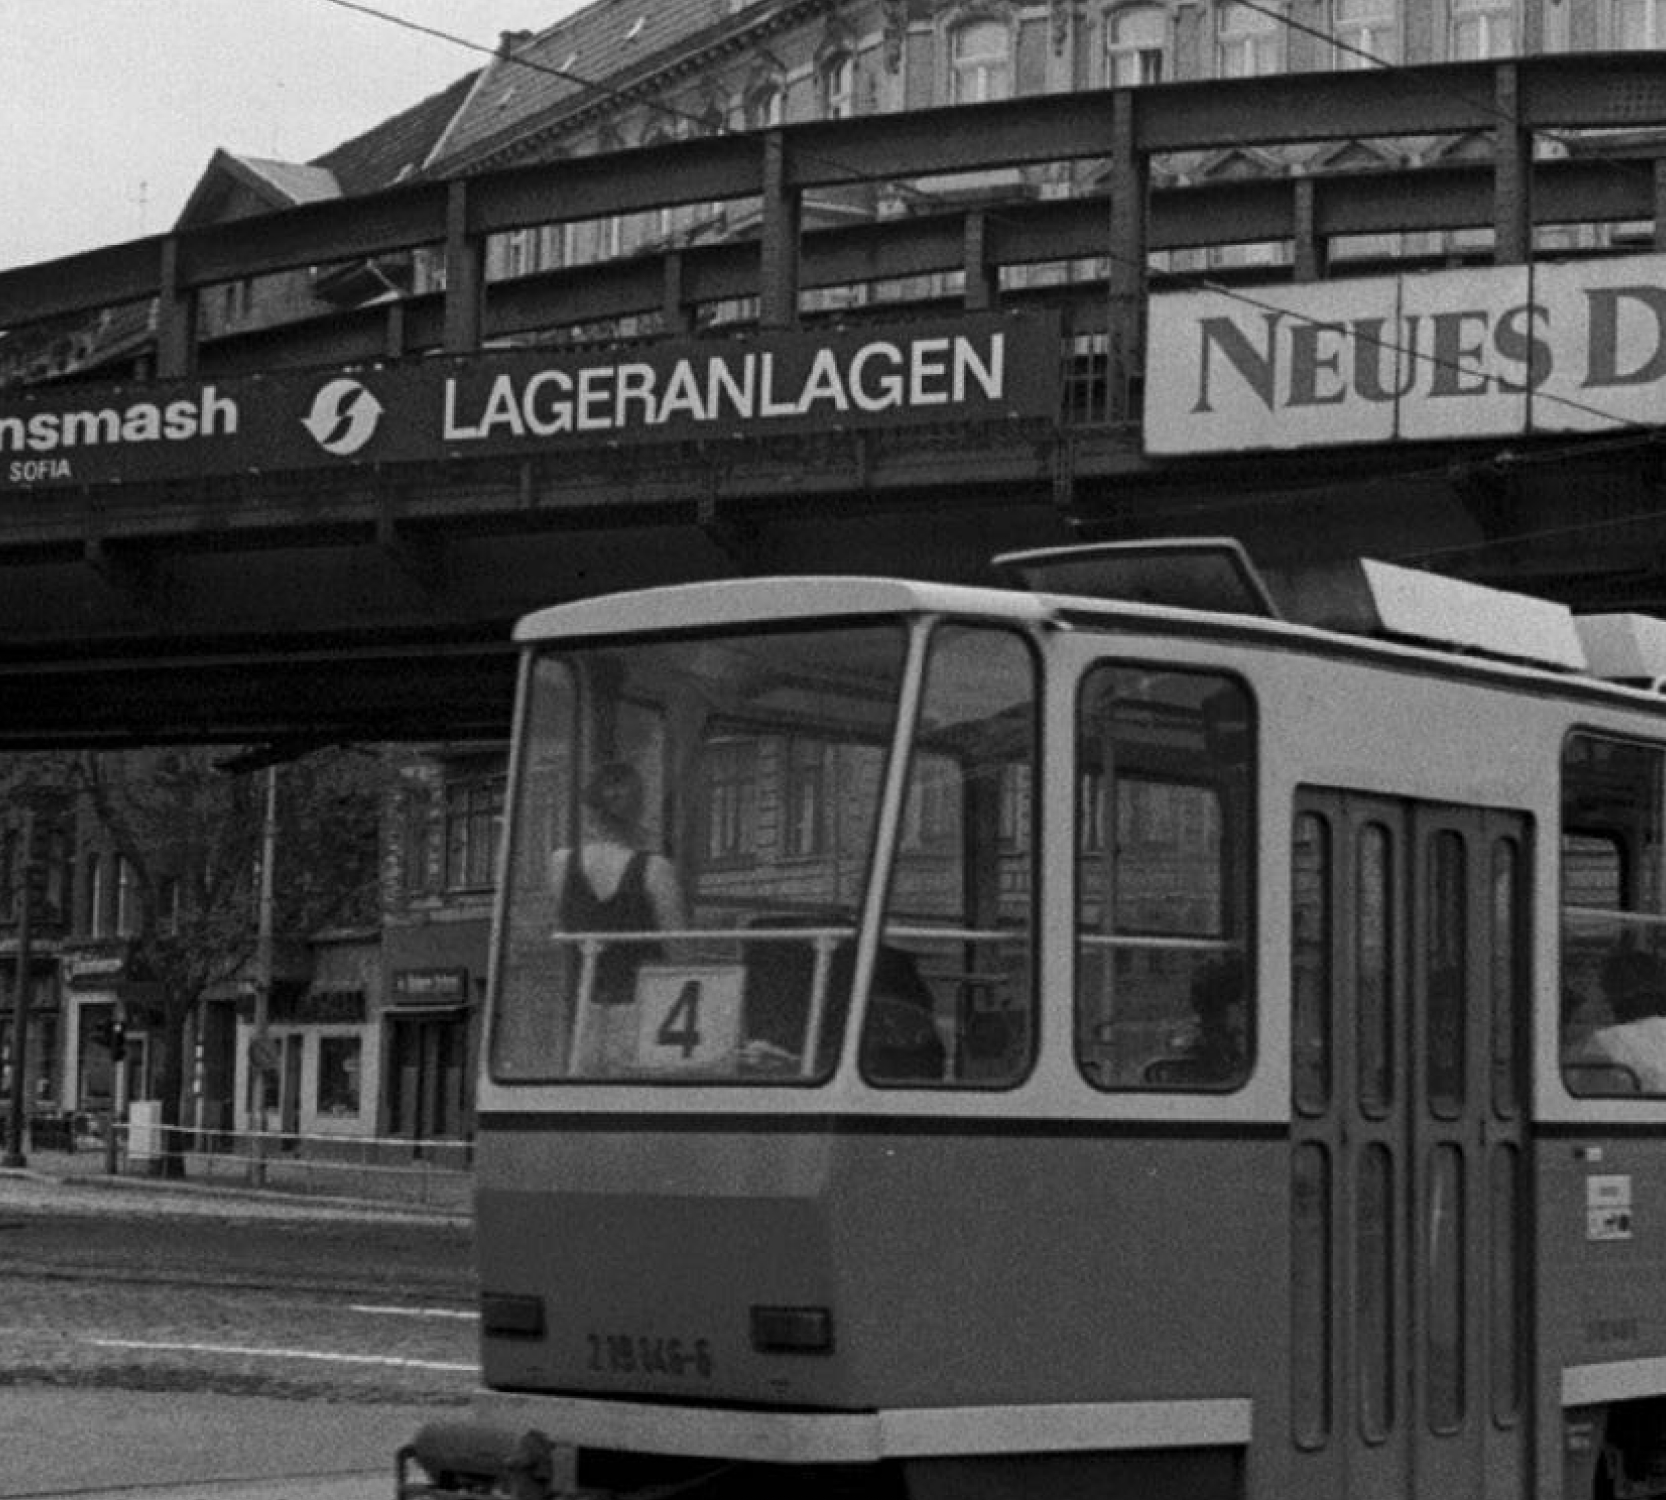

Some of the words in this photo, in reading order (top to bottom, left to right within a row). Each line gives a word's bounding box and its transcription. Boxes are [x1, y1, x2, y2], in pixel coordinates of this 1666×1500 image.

[444, 333, 1005, 441] LAGERANLAGEN
[1190, 301, 1551, 415] NEUES
[9, 461, 72, 483] SOFIA
[656, 980, 702, 1059] 4
